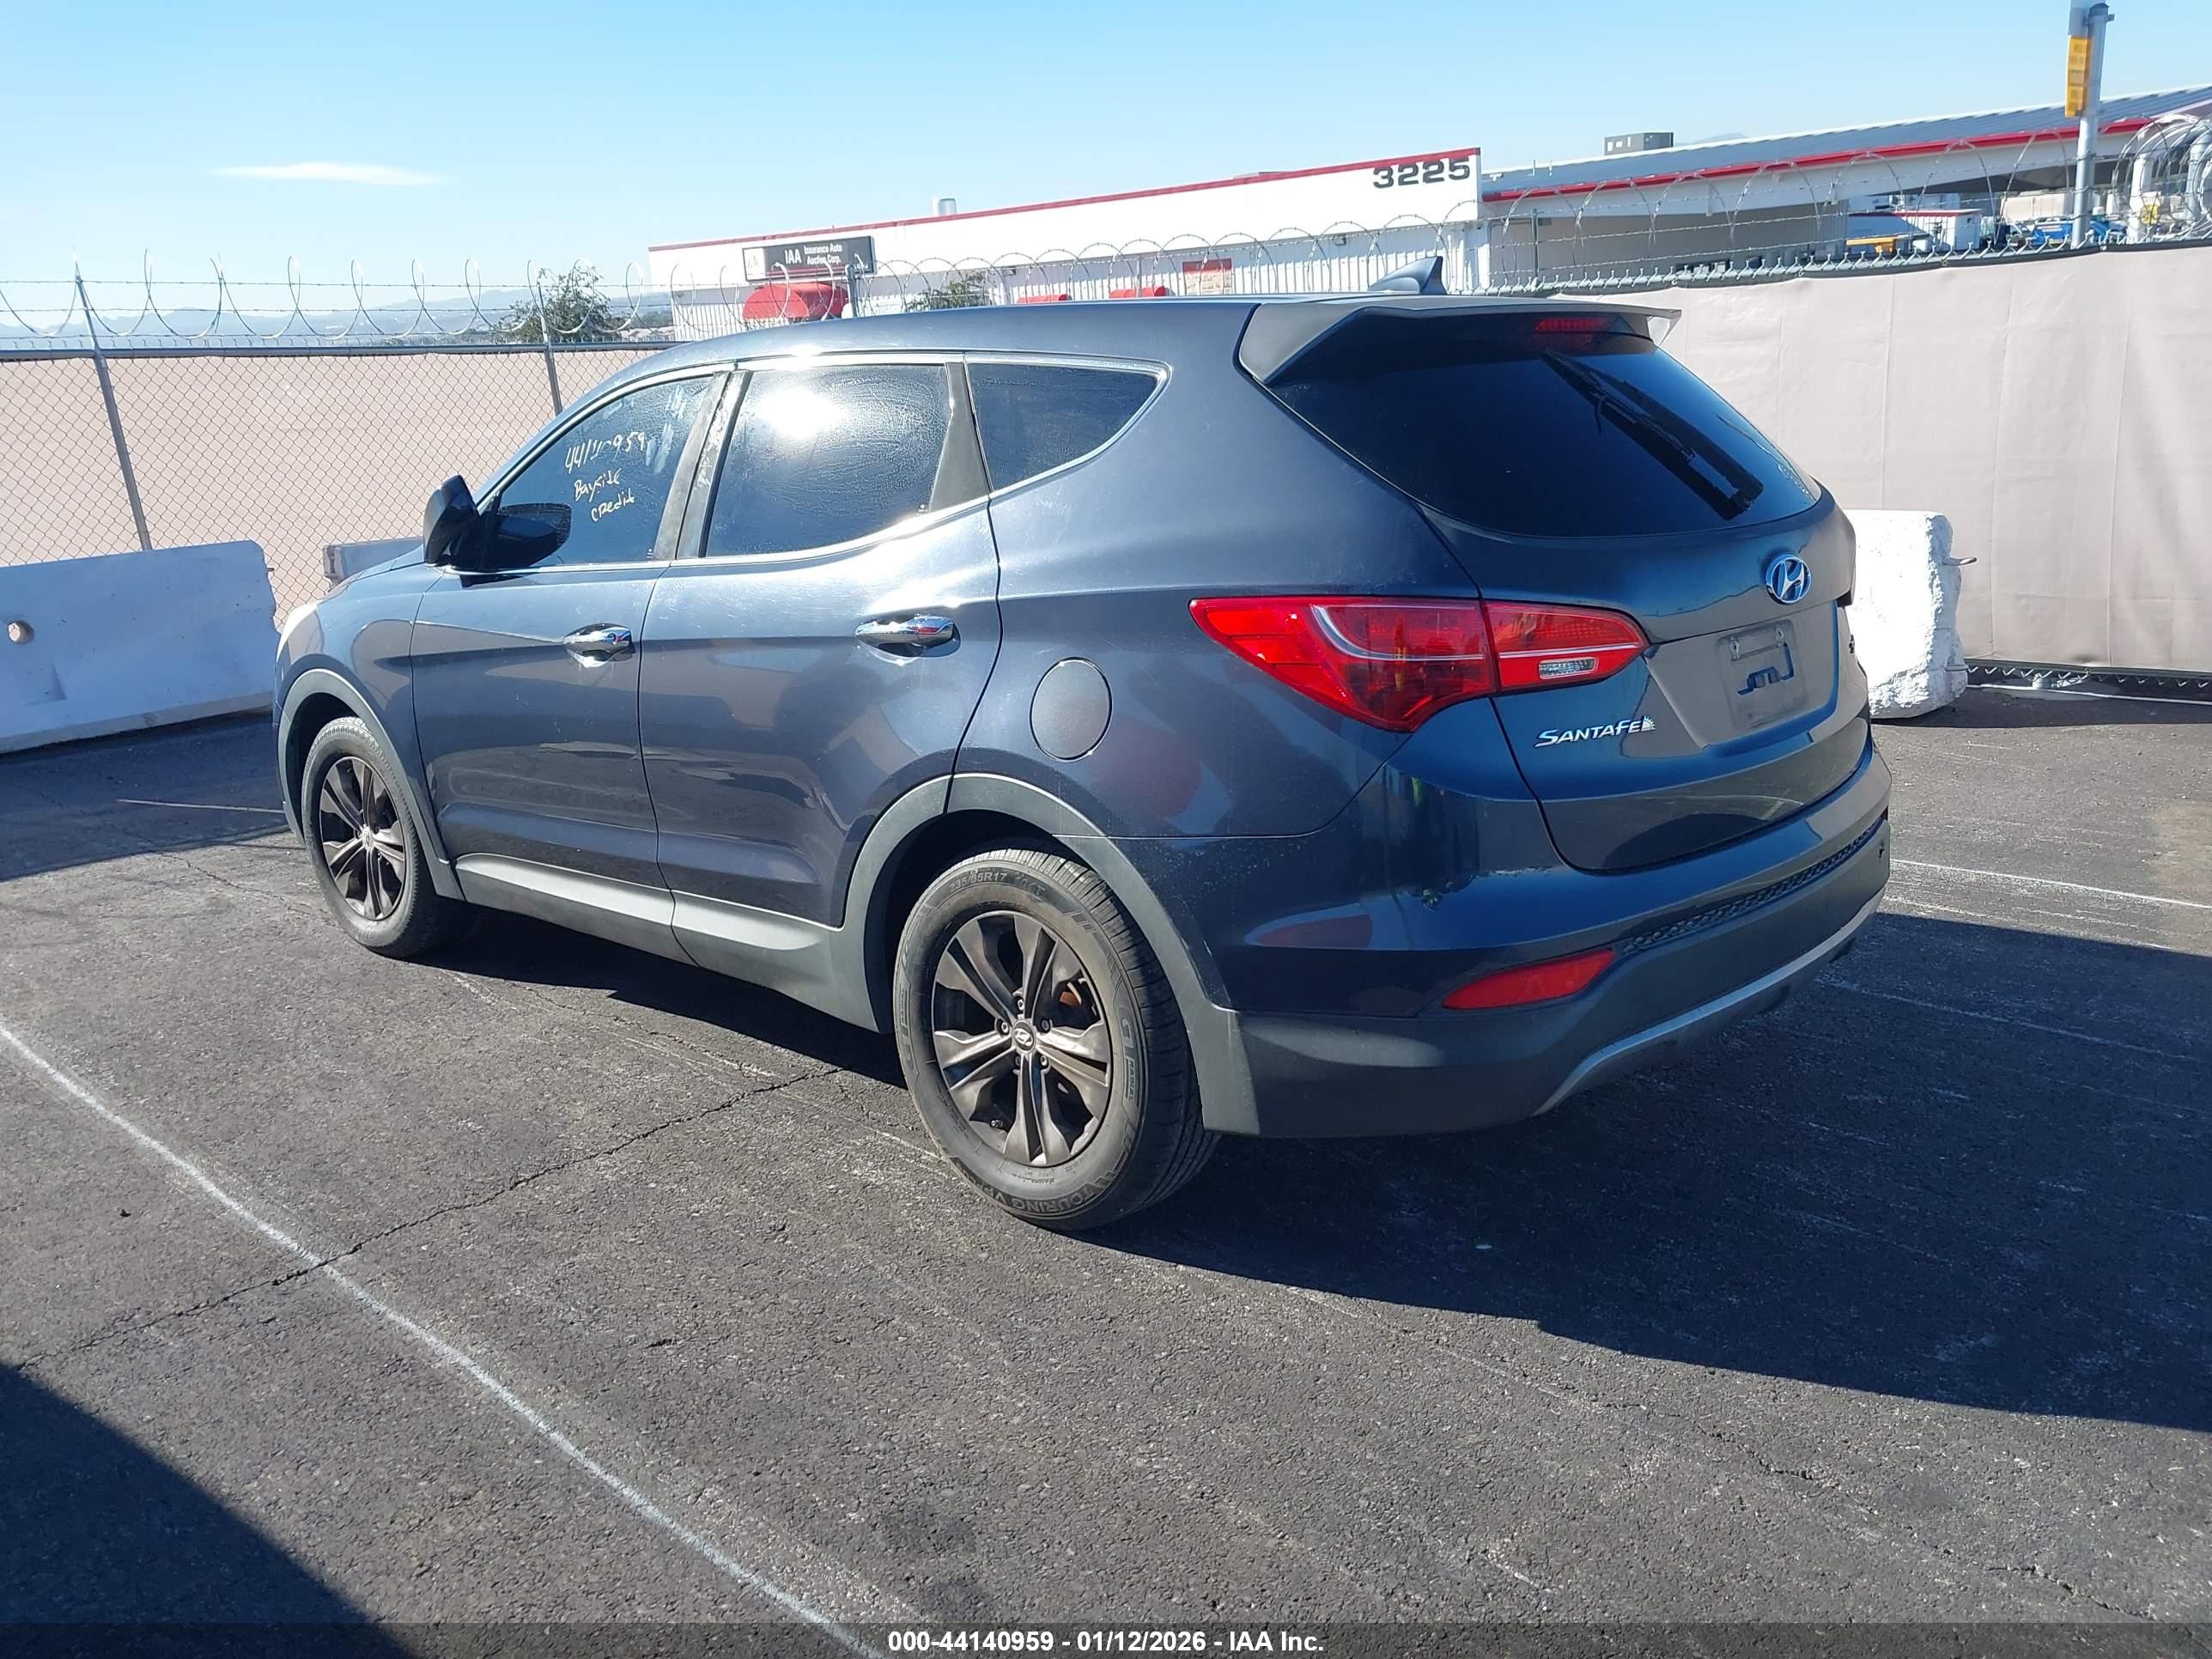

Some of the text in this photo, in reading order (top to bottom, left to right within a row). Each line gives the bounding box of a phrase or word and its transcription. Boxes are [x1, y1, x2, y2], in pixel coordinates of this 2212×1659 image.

[1373, 157, 1470, 189] 3225
[784, 248, 802, 264] IAA
[804, 243, 843, 255] Insurance Auto
[1012, 1184, 1097, 1213] TOURING
